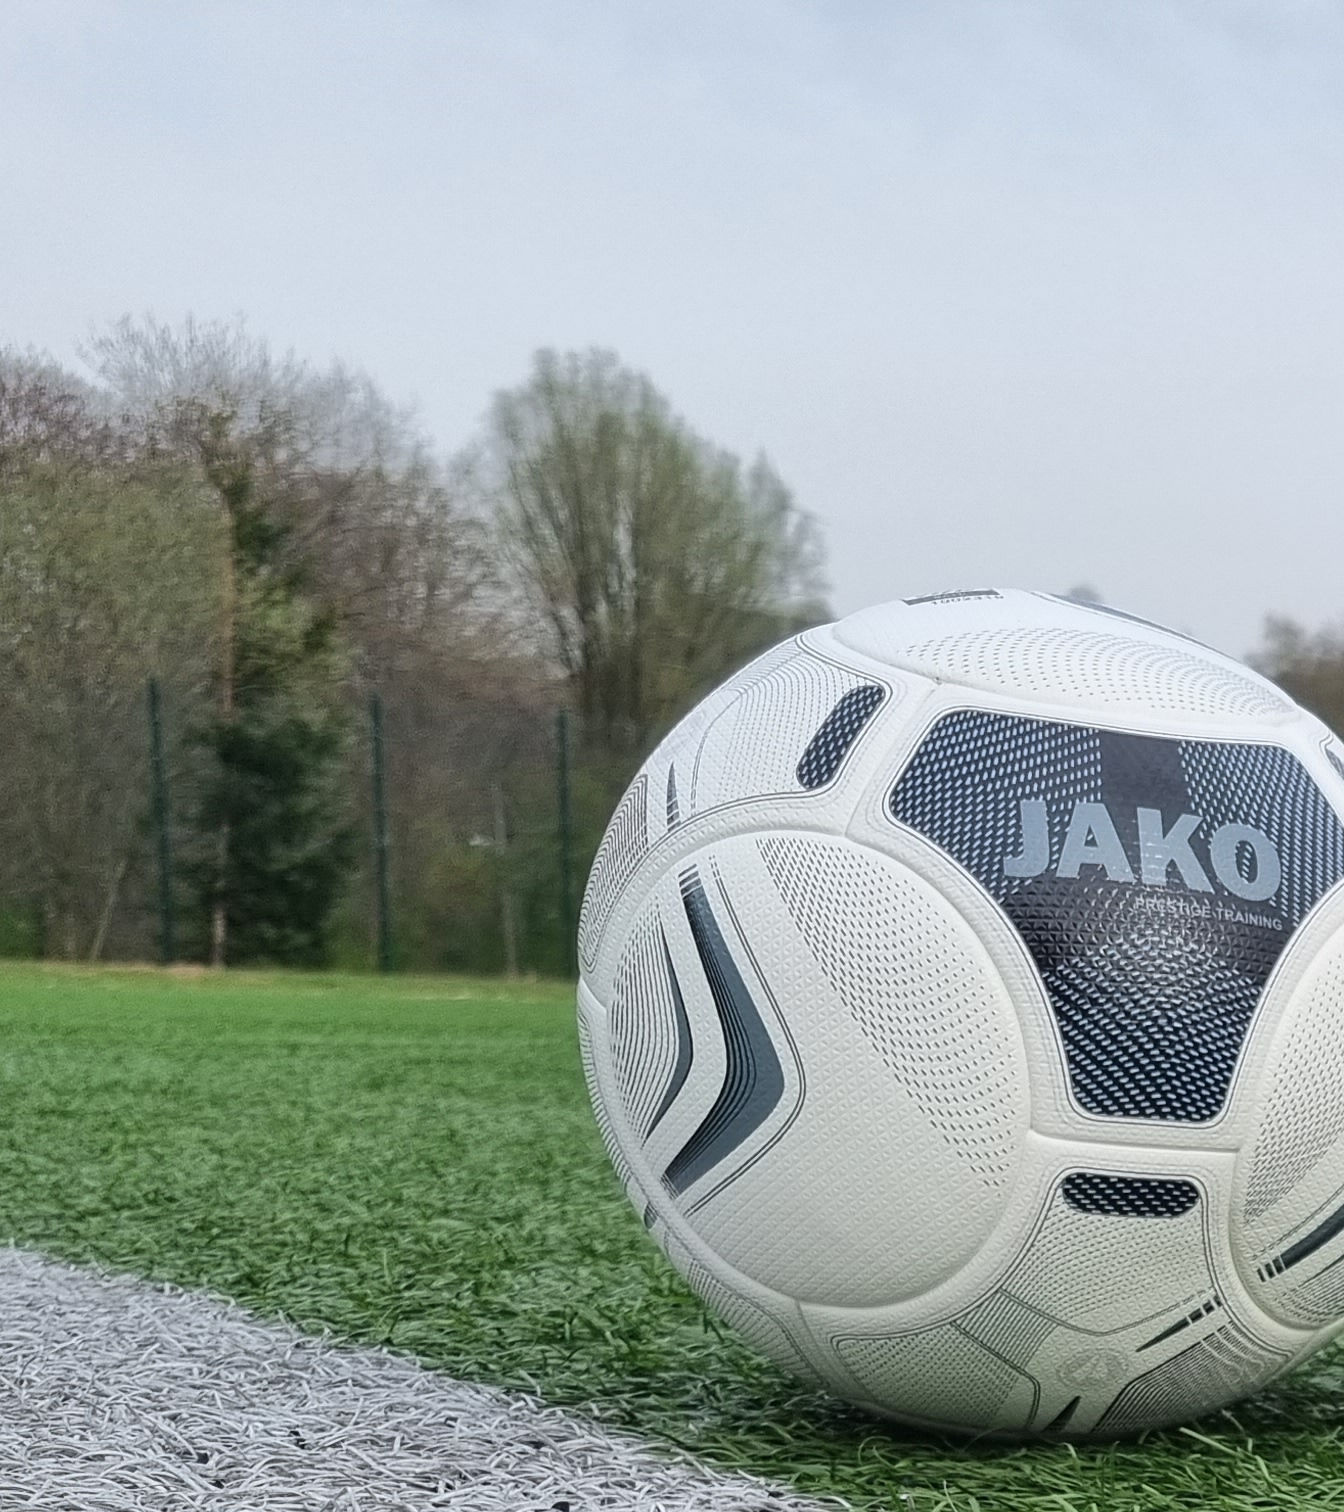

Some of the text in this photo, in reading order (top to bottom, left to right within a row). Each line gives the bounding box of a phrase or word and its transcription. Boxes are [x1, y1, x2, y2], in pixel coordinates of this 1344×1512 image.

[1002, 800, 1283, 902] JAKO
[1134, 897, 1283, 931] PRESTIGE TRAINING
